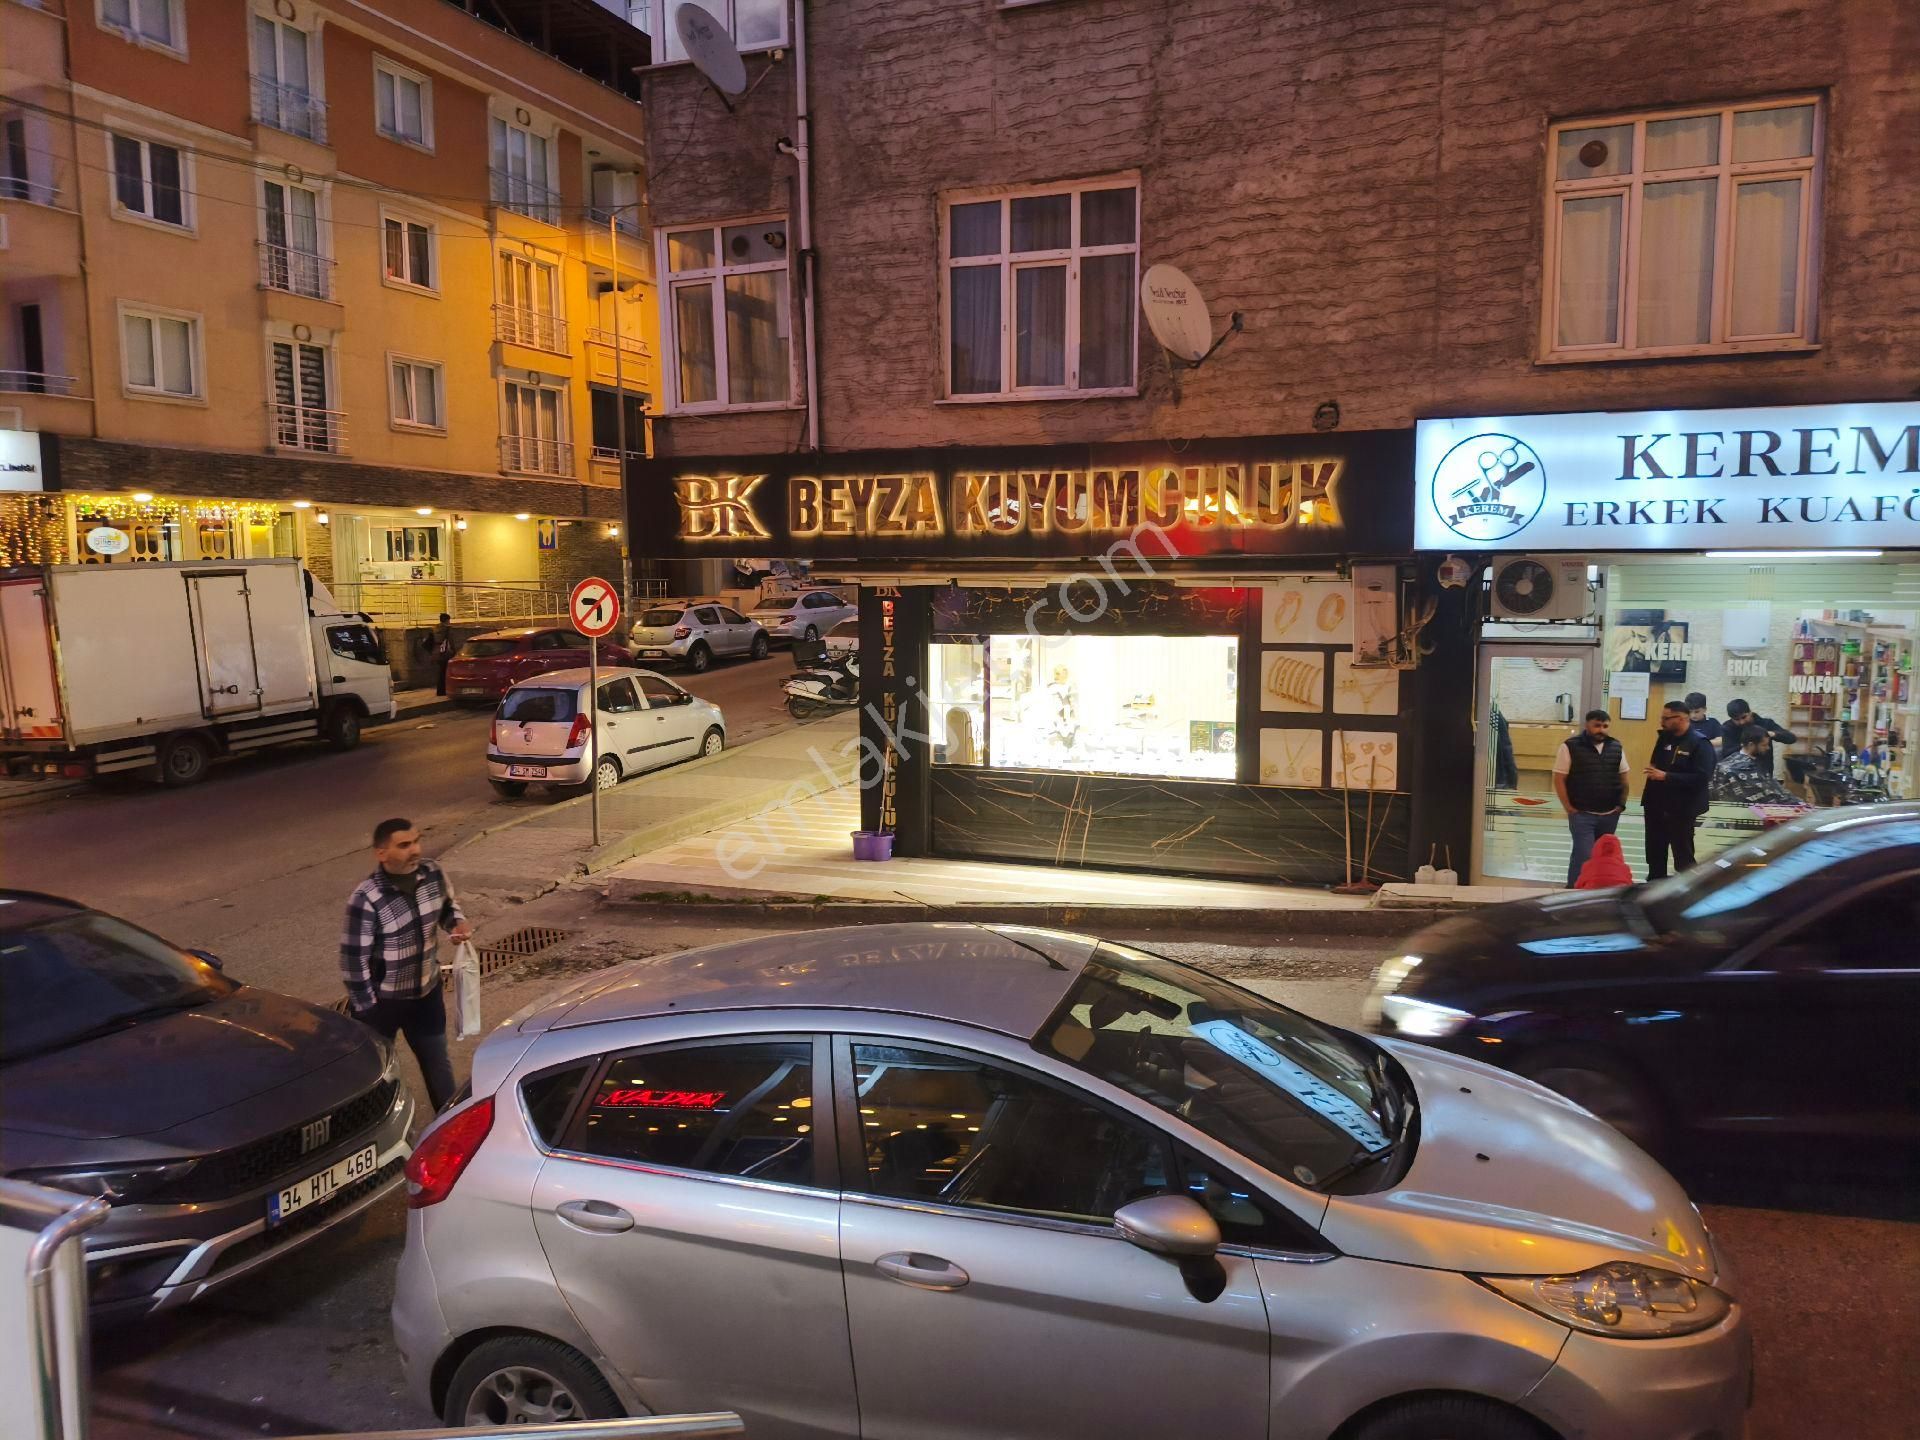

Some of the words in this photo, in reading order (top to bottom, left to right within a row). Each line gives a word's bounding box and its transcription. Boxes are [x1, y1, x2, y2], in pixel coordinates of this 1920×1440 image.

[1615, 425, 1920, 480] KEREM
[674, 474, 772, 540] BK
[789, 473, 943, 535] BEYZA
[952, 460, 1345, 533] KUYUMCULUK
[1462, 505, 1511, 516] KEREM
[1563, 498, 1728, 526] ERKEK
[882, 600, 895, 677] BEYZA
[1645, 642, 1711, 661] KEREM
[1726, 659, 1768, 677] ERKEK
[1789, 671, 1842, 694] KUAFÖR
[301, 1115, 332, 1155] FIAT
[282, 1188, 302, 1213] 34
[311, 1169, 339, 1199] HTL
[346, 1149, 373, 1177] 468
